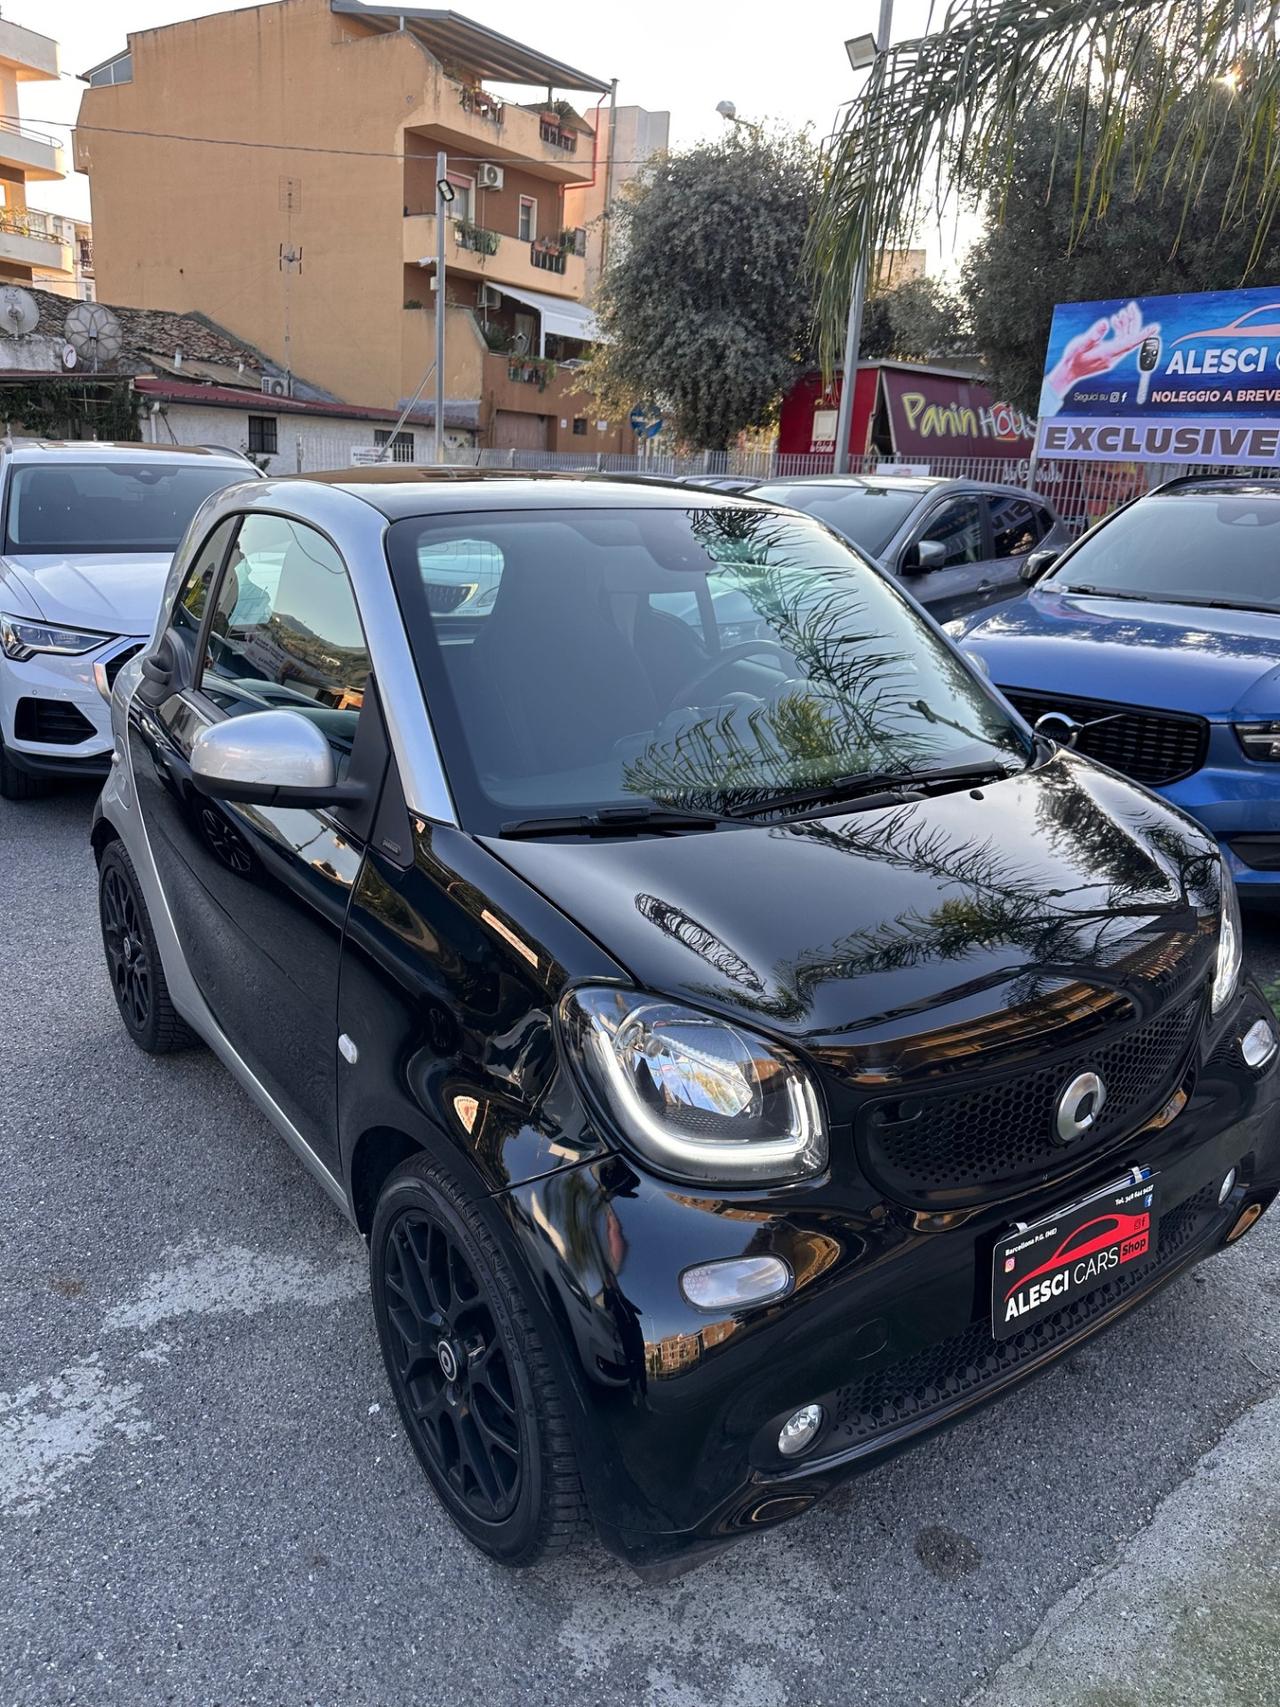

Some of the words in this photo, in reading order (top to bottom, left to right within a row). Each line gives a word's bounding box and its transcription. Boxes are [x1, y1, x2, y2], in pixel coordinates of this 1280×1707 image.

[1164, 347, 1268, 375] ALESCI
[1073, 392, 1098, 402] Seguici
[1099, 393, 1108, 401] su
[1151, 390, 1222, 403] NOLEGGIO
[1223, 391, 1233, 402] A
[1236, 389, 1280, 402] BREVE
[900, 391, 979, 439] Panin
[1044, 425, 1279, 457] EXCLUSIVE
[1005, 1239, 1034, 1256] Barcellona
[1005, 1269, 1069, 1322] ALESCI
[1073, 1246, 1119, 1285] CARS
[1122, 1238, 1146, 1257] Shop
